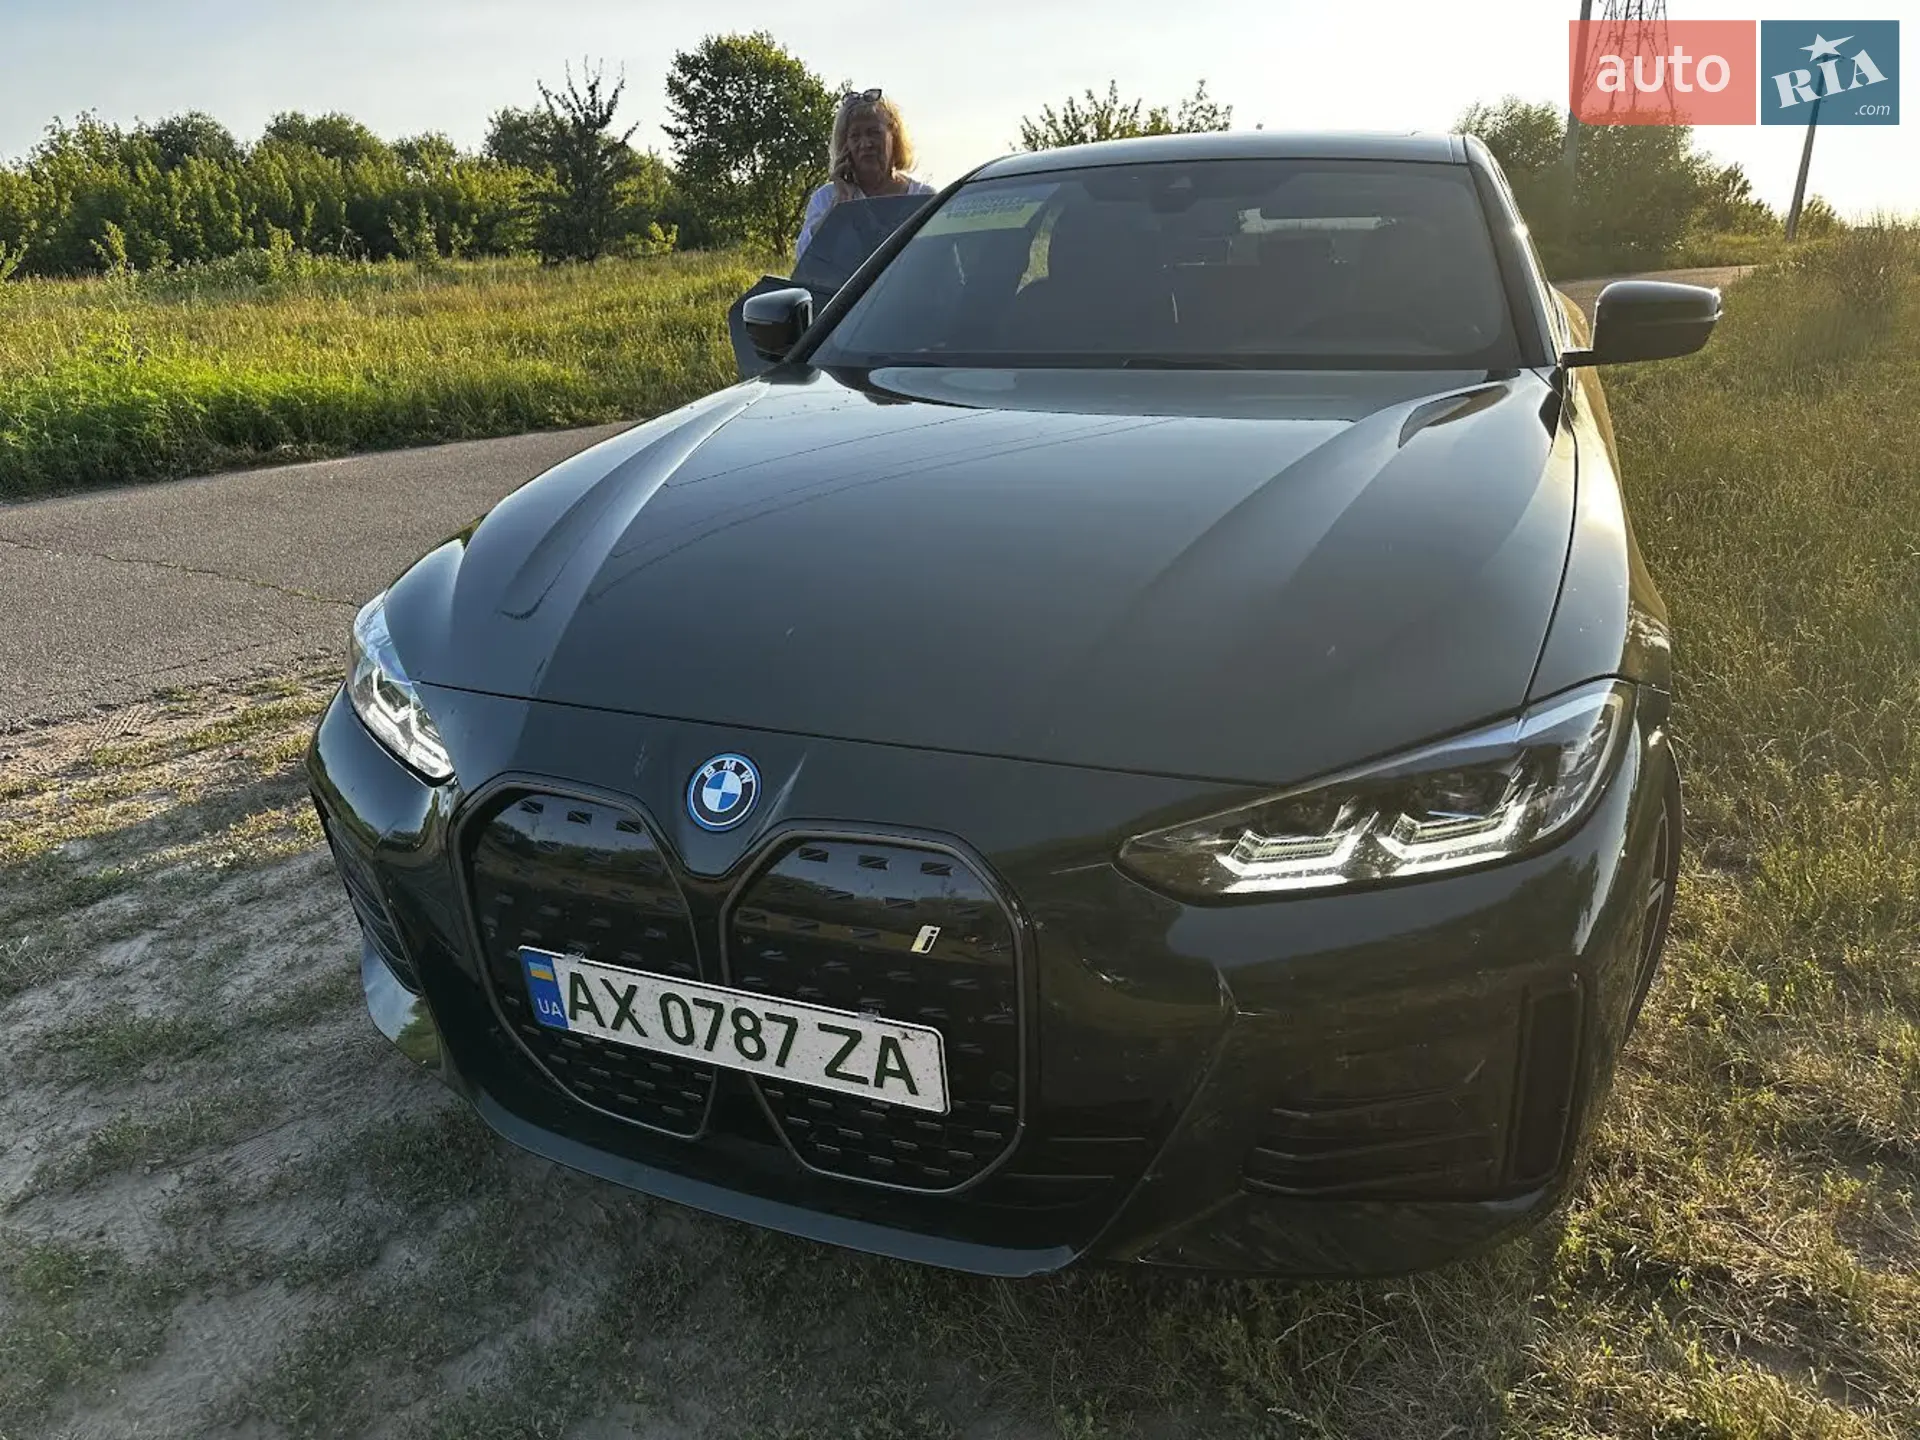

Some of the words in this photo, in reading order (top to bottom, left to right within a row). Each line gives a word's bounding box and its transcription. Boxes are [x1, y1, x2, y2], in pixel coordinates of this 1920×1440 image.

[703, 760, 753, 784] BMW
[538, 997, 563, 1018] UA
[568, 971, 649, 1038] AX
[659, 992, 799, 1067] 0787
[817, 1022, 919, 1096] ZA
